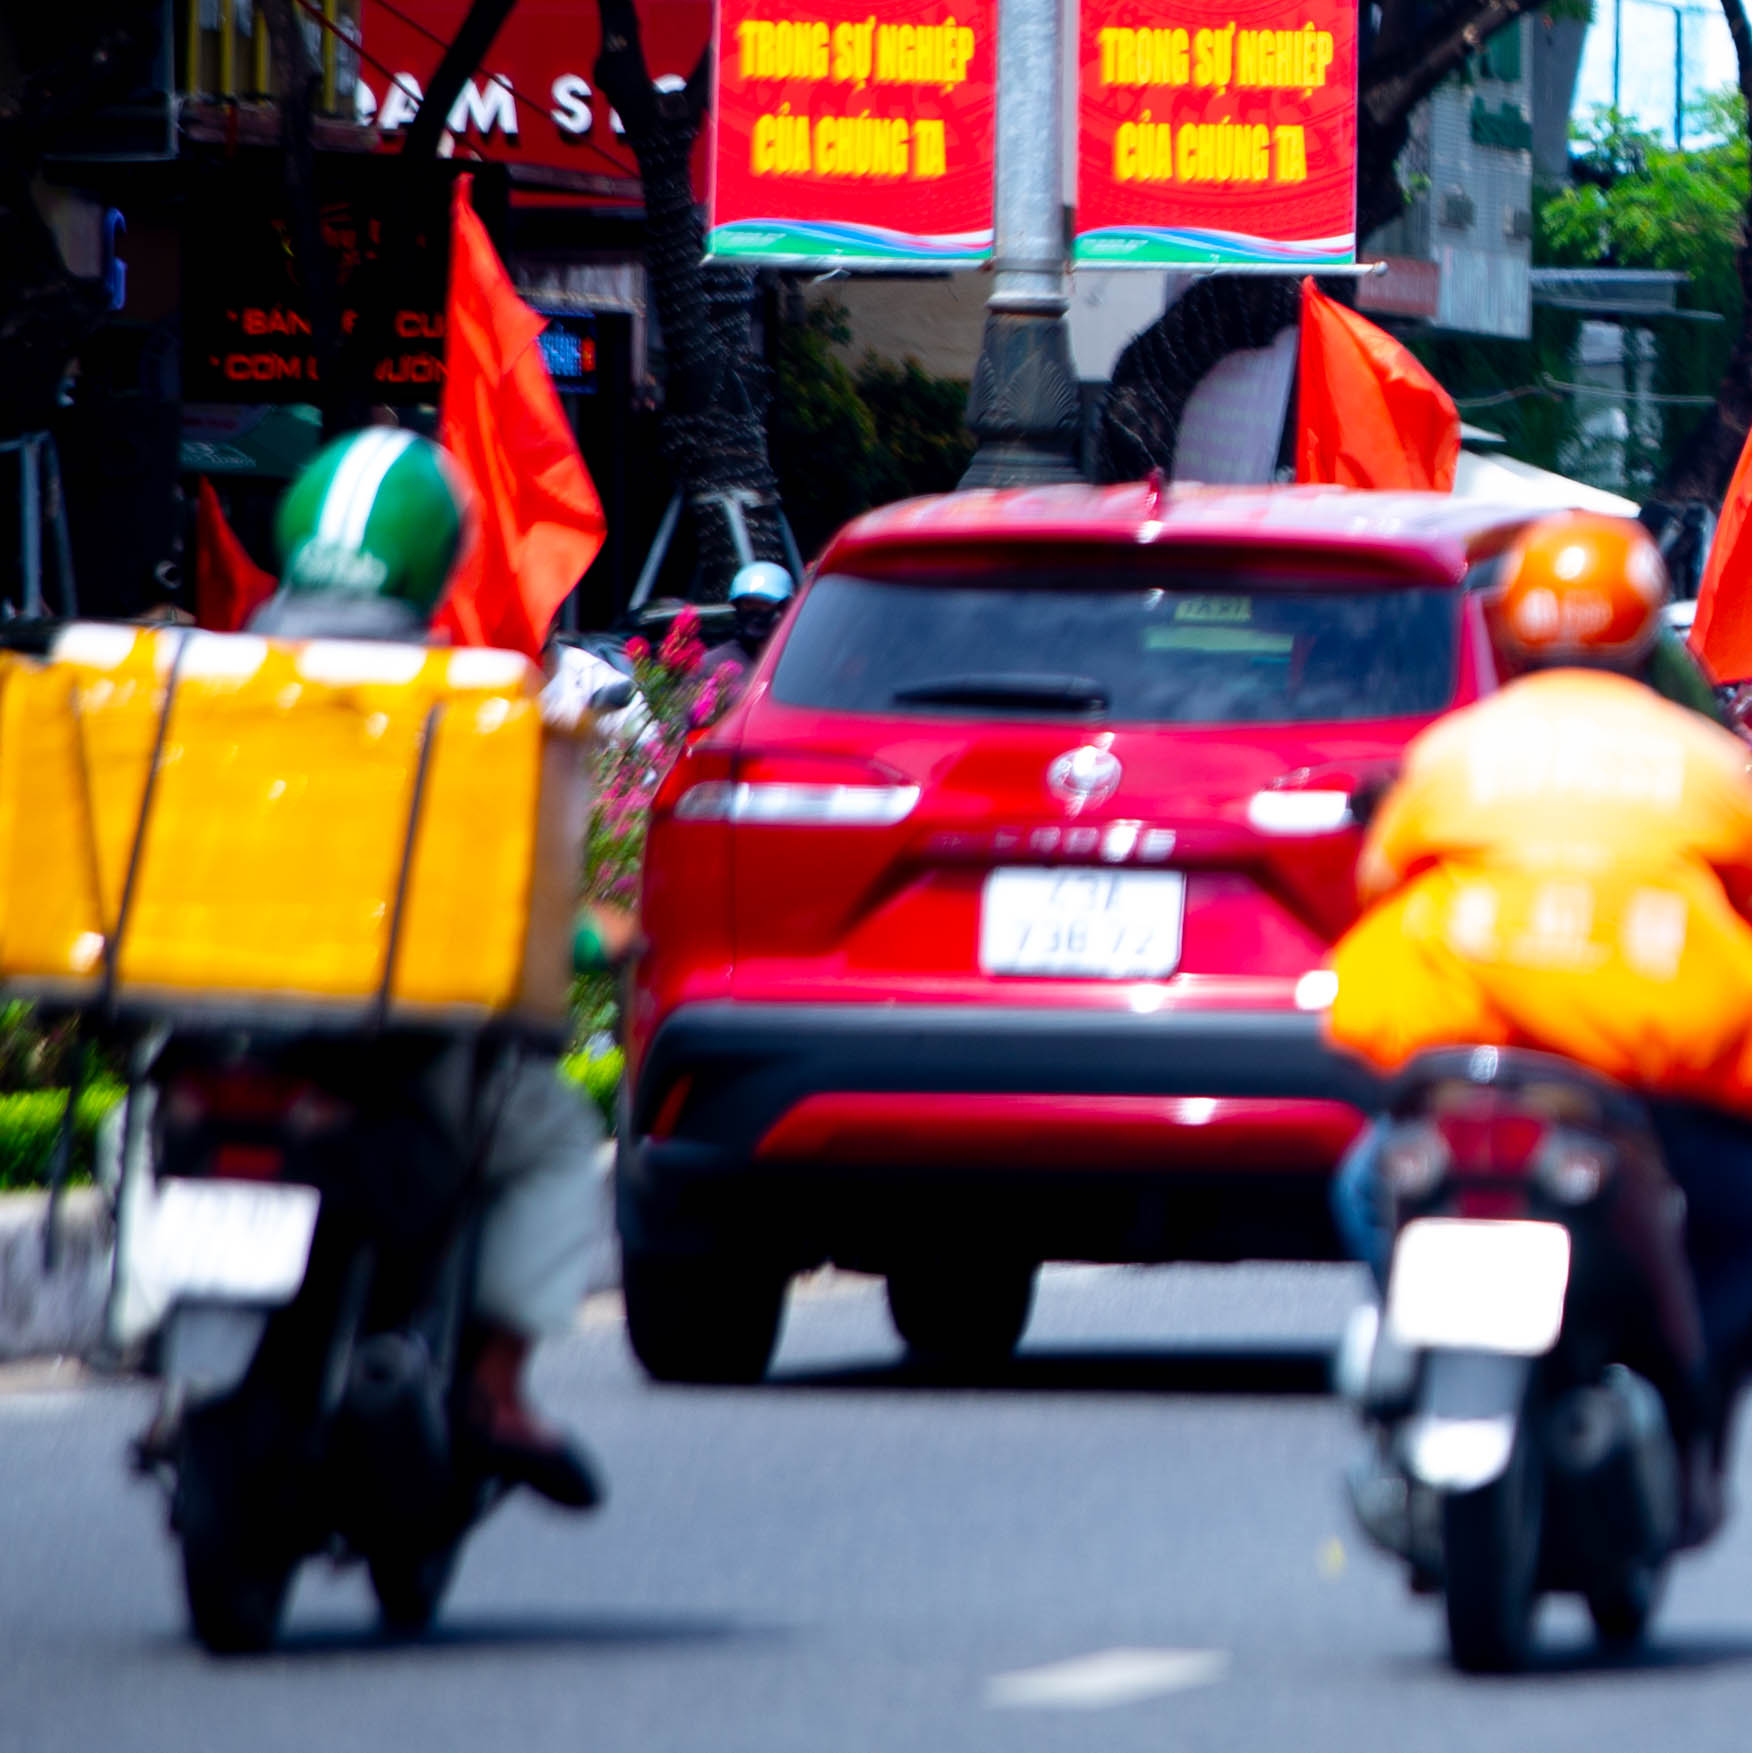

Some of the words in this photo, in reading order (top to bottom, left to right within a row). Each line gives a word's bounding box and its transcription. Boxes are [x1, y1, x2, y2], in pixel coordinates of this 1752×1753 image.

[739, 20, 829, 80] TRONG
[833, 15, 875, 90] SỰ
[876, 16, 974, 94] NGHIỆP
[1100, 27, 1190, 87] TRONG
[1193, 21, 1235, 97] SỰ
[1237, 21, 1333, 98] NGHIỆP
[752, 102, 811, 176] CỦA
[814, 109, 908, 176] CHÚNG
[913, 119, 947, 178] TA
[1114, 109, 1172, 183] CỦA
[1176, 115, 1269, 183] CHÚNG
[1274, 124, 1307, 184] TA
